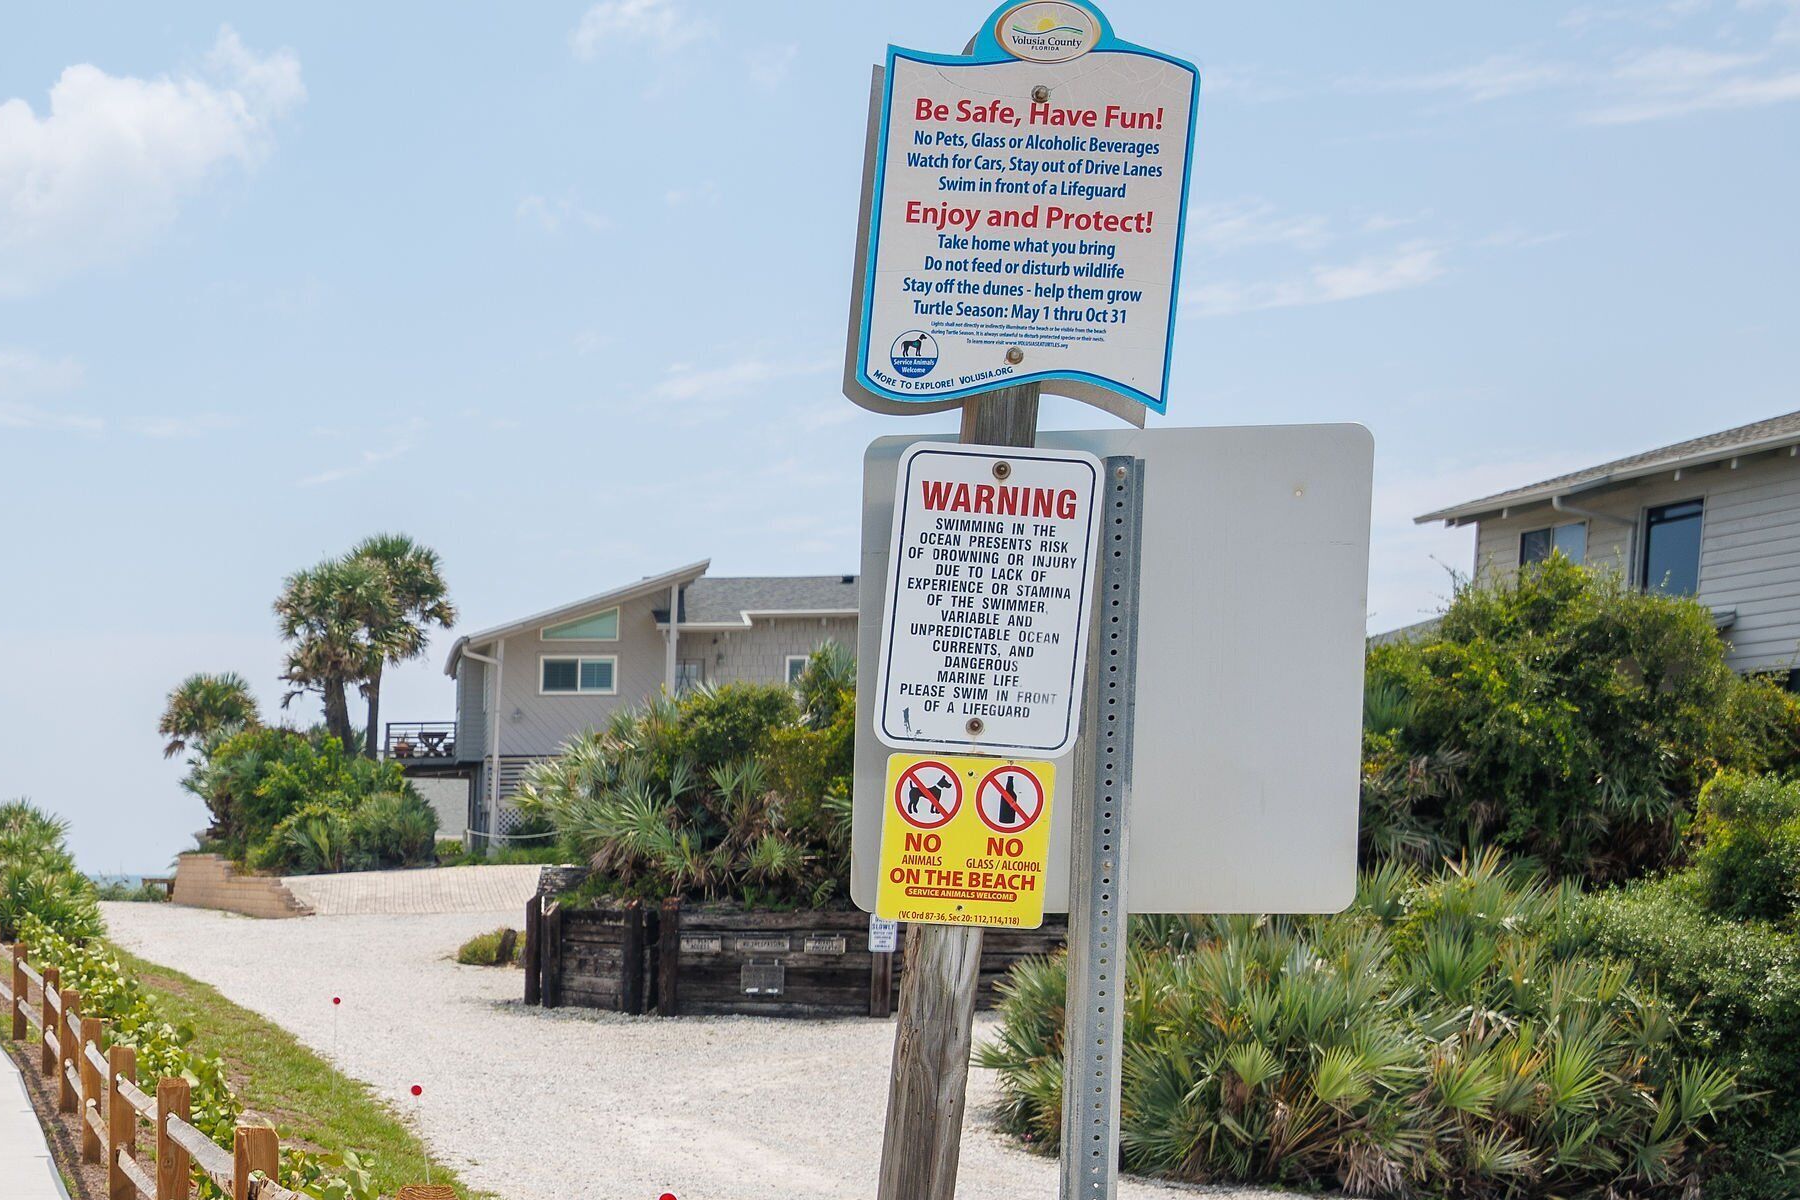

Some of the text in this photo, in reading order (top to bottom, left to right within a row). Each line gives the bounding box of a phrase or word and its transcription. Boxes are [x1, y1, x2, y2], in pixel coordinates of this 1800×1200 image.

[1011, 35, 1083, 50] Volusia County
[916, 98, 1164, 130] Be Safe, Have Fun!
[914, 130, 1160, 158] No Pets, Glass Alcoholic Beverages
[907, 152, 1163, 178] Watch for Cars, Stay out Drive Lanes
[938, 176, 1127, 201] Swim front Lifeguard
[906, 201, 1153, 234] Enjoy and Protect!
[938, 234, 1116, 260] Take home what you bring
[924, 256, 1125, 279] Do not feed or disturb wildlife
[902, 277, 1143, 305] Stay off the dunes help them grow
[913, 300, 1127, 324] Turtle Season: May thru Oct 31
[893, 358, 935, 367] Service Animals
[901, 366, 926, 374] Welcome
[922, 480, 1077, 520] WARNING
[936, 517, 1057, 538] SWIMMING IN THE
[920, 532, 1069, 554] OCEAN PRESENTS RISK
[908, 546, 1077, 569] OF DROWNING OR INJURY
[936, 564, 961, 577] DUE
[991, 567, 1023, 582] LACK
[1031, 570, 1047, 583] OF
[907, 577, 1071, 600] EXPERIENCE OR STAMINA
[927, 593, 943, 606] OF
[951, 595, 975, 609] THE
[941, 610, 1032, 628] VARIABLE AND
[910, 623, 1060, 645] UNPREDICTABLE OCEAN
[932, 639, 1034, 658] CURRENTS, AND
[944, 655, 1018, 672] DANGEROUS
[937, 670, 986, 685] MARINE
[900, 683, 1056, 704] PLEASE SWIM IN FRONT
[924, 700, 1030, 718] OF LIFEGUARD
[905, 832, 942, 853] NO
[987, 837, 1024, 858] NO
[901, 854, 942, 867] ANIMALS
[966, 858, 1042, 873] GLASS ALCOHOL
[890, 867, 1036, 891] ON THE BEACH
[908, 888, 1014, 901] SERVICE ANIMALS WELCOME
[898, 910, 911, 920] (VC
[911, 911, 924, 920] Ord
[924, 912, 947, 922] 87-36,
[948, 913, 961, 922] Sec
[961, 914, 973, 923] 20:
[974, 915, 1020, 926] 112,114,118)
